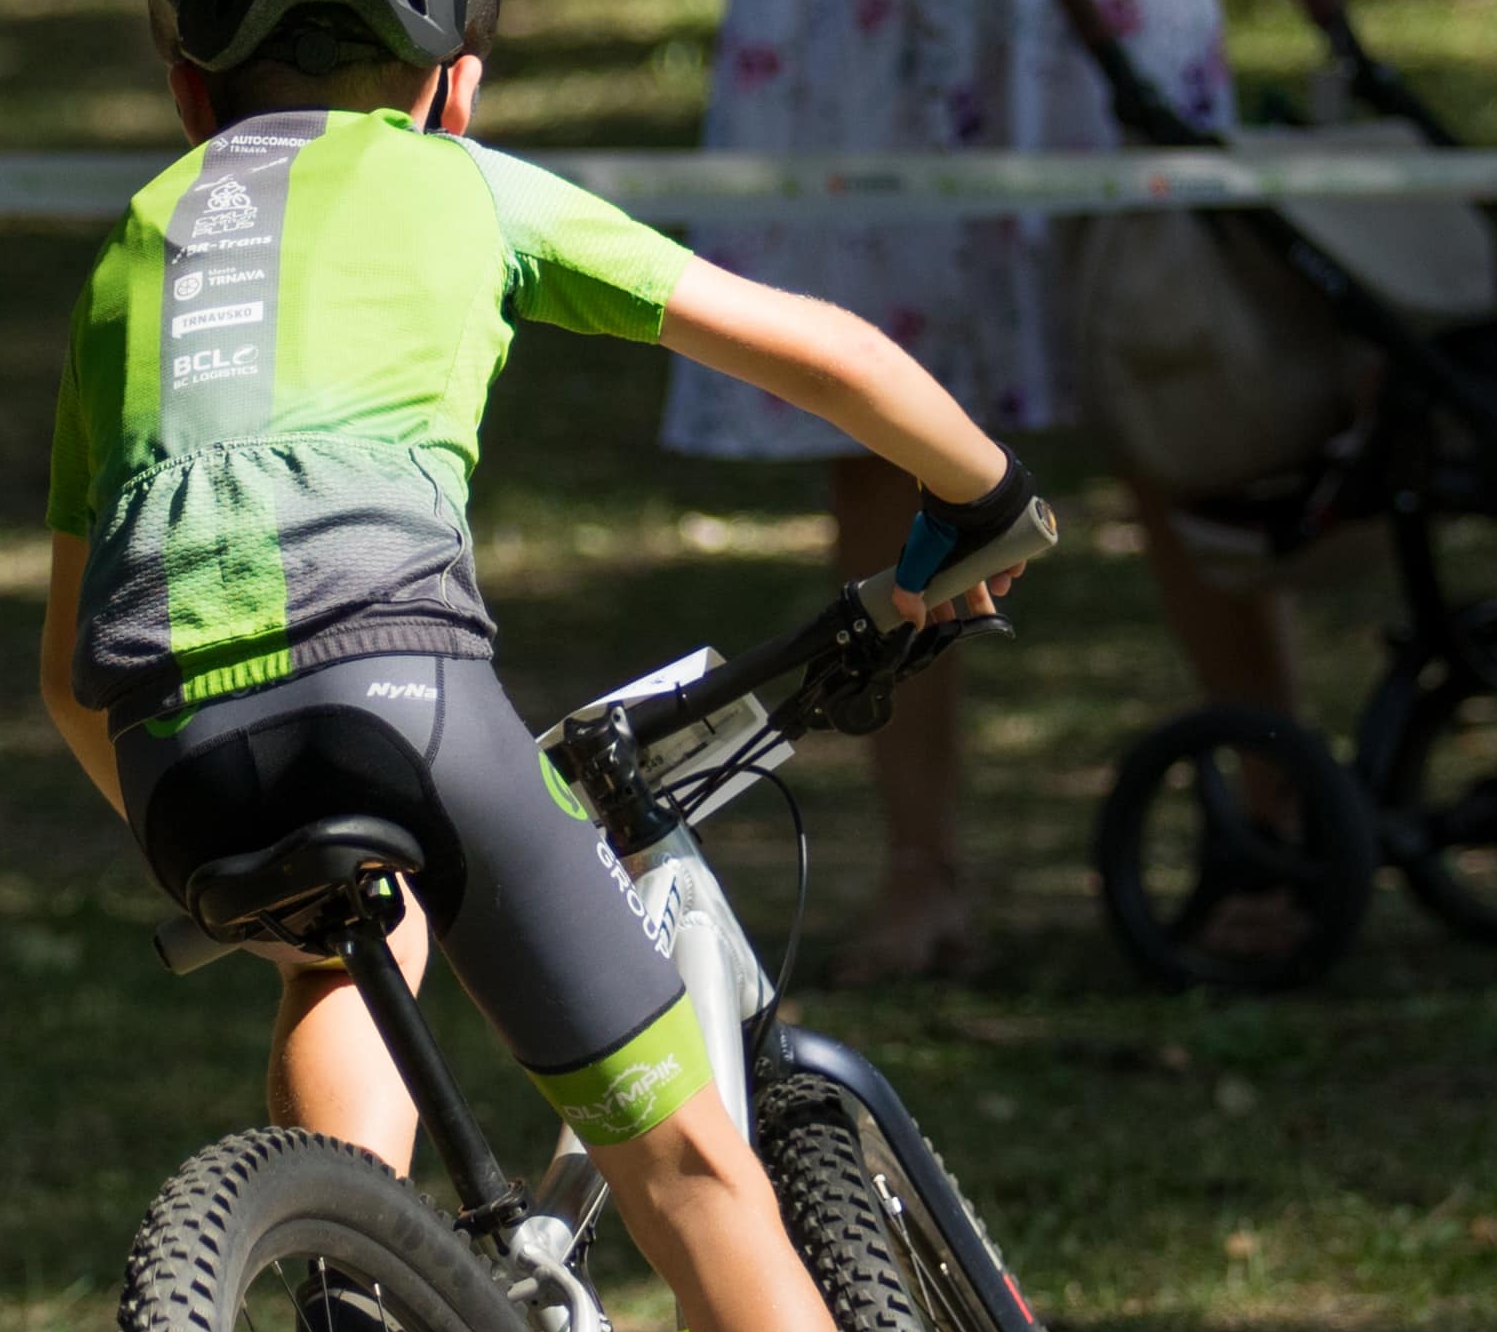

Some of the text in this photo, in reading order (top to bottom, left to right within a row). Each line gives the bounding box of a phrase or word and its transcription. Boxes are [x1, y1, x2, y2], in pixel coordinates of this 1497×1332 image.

[209, 269, 266, 286] TRNAVA
[182, 307, 253, 328] TRNAVSKO
[173, 348, 231, 378] BCL
[173, 364, 259, 390] BC LOGISTICS
[596, 840, 672, 960] GROUP
[562, 1052, 683, 1120] OLYMPIK
